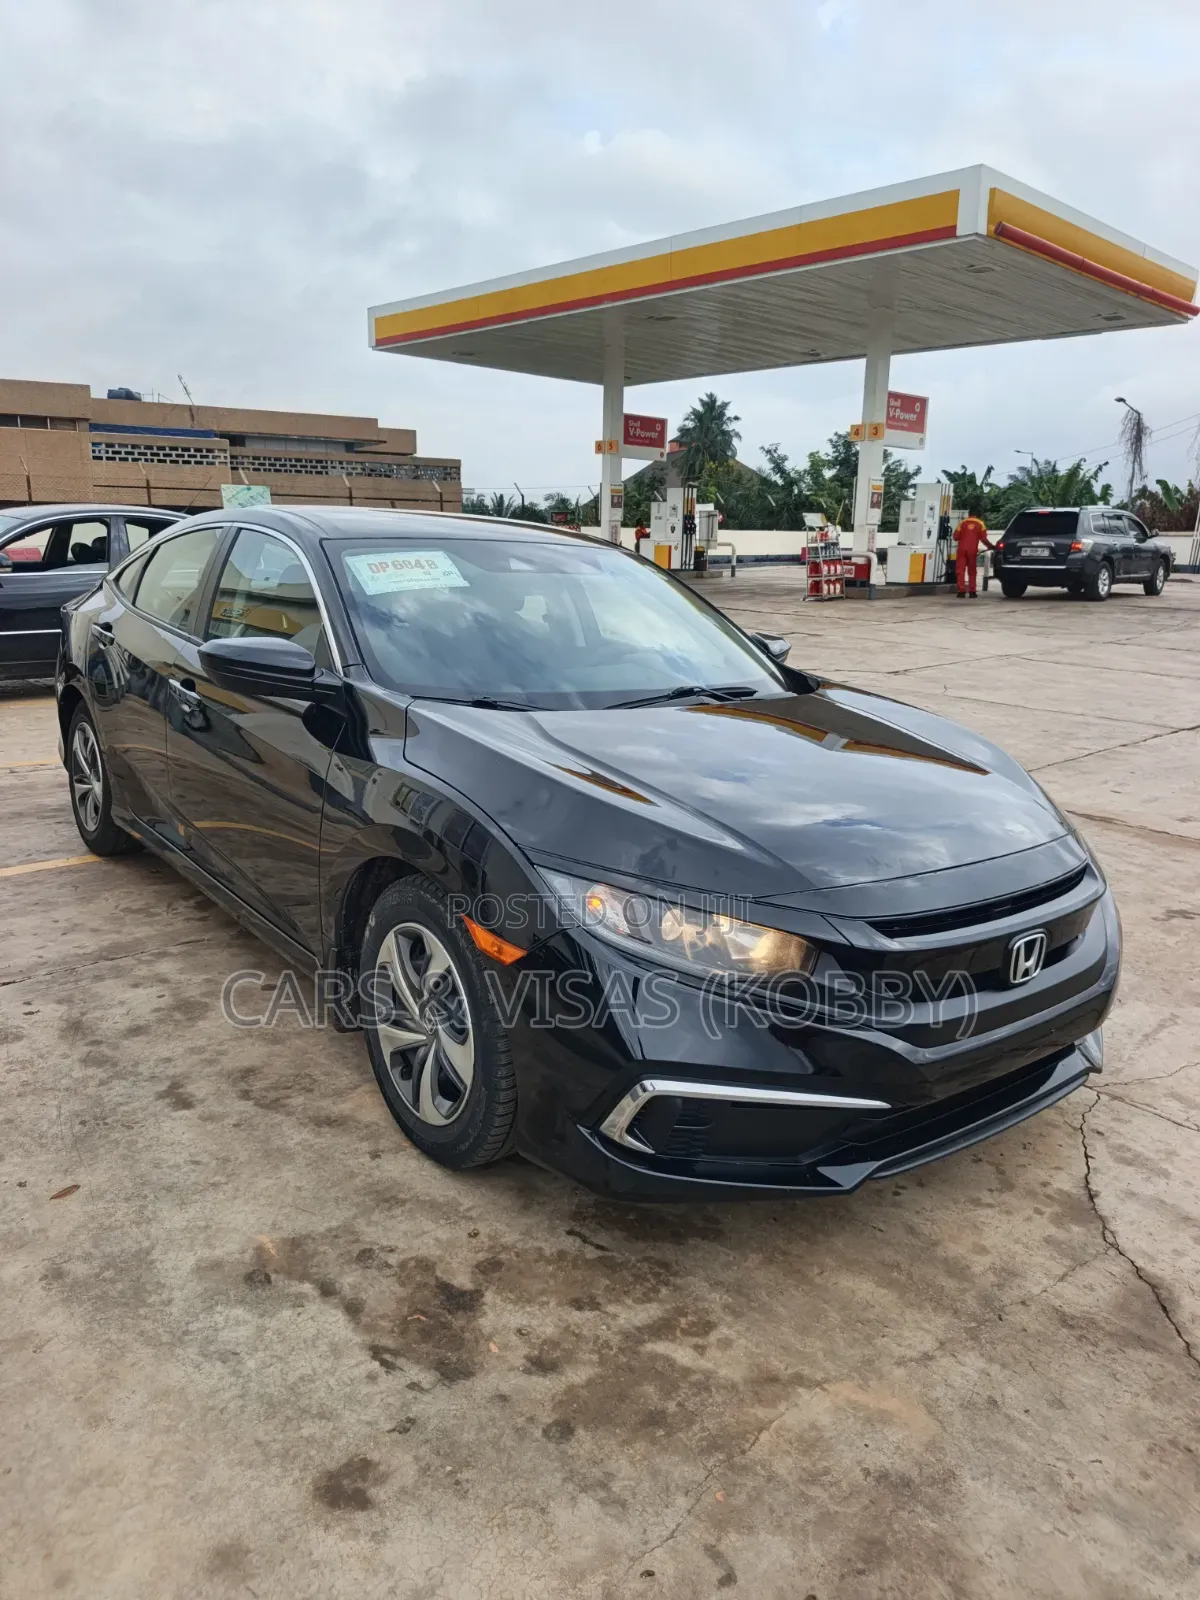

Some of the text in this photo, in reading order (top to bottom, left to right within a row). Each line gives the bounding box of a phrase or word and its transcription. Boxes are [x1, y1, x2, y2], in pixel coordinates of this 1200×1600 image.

[889, 398, 901, 407] Shell
[888, 407, 918, 422] V-Power
[628, 420, 640, 428] Shell
[628, 427, 659, 439] V-Power
[853, 427, 860, 437] 4
[872, 426, 879, 436] 3
[366, 561, 390, 574] DP
[425, 559, 439, 570] B
